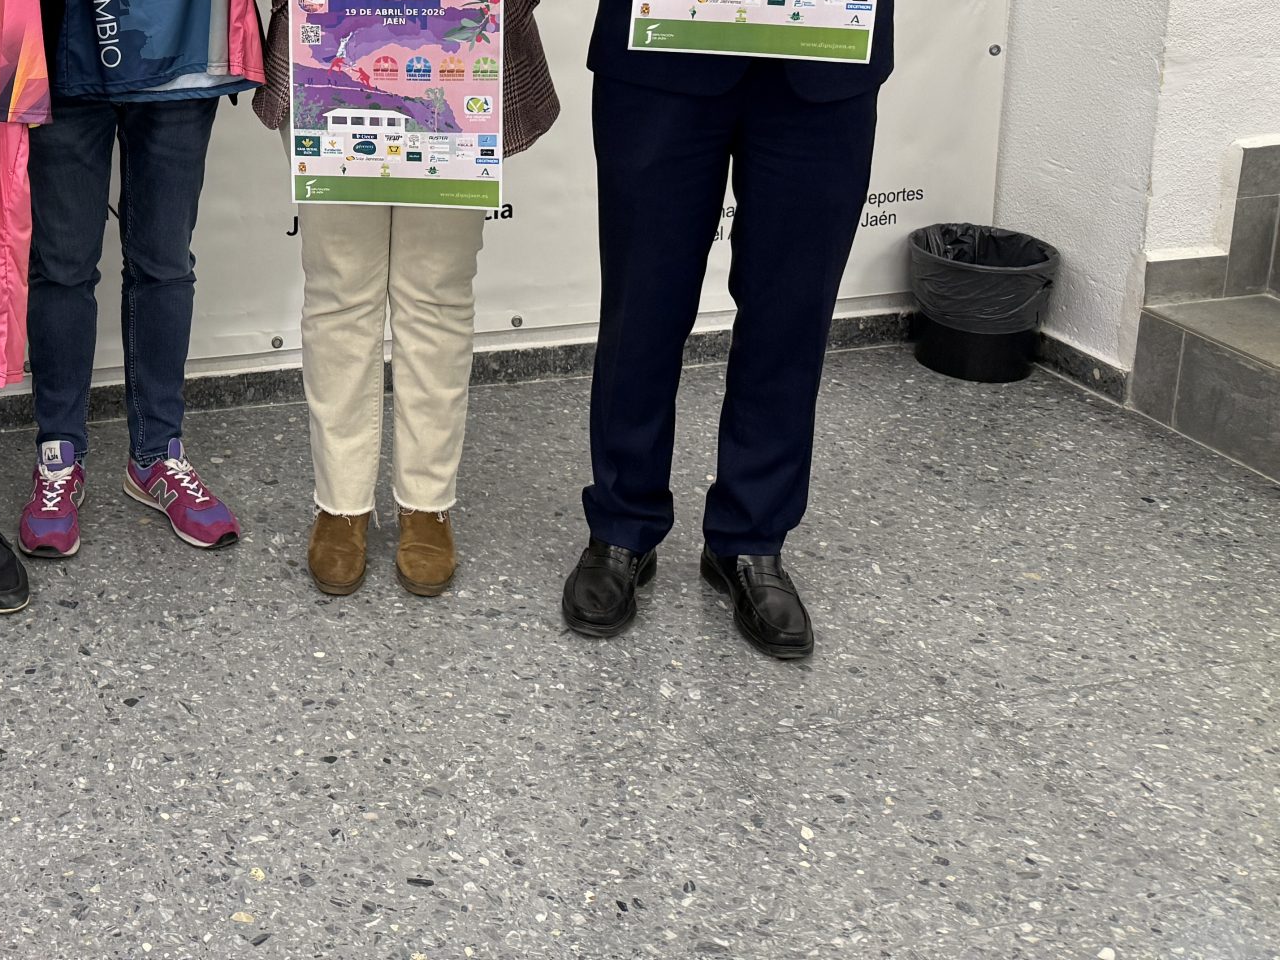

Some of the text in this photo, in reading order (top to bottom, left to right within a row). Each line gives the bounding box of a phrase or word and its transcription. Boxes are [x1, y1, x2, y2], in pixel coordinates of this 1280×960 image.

[421, 8, 446, 16] 2026
[382, 16, 406, 26] JAÉN
[868, 188, 924, 208] eportes
[861, 211, 897, 228] Jaén
